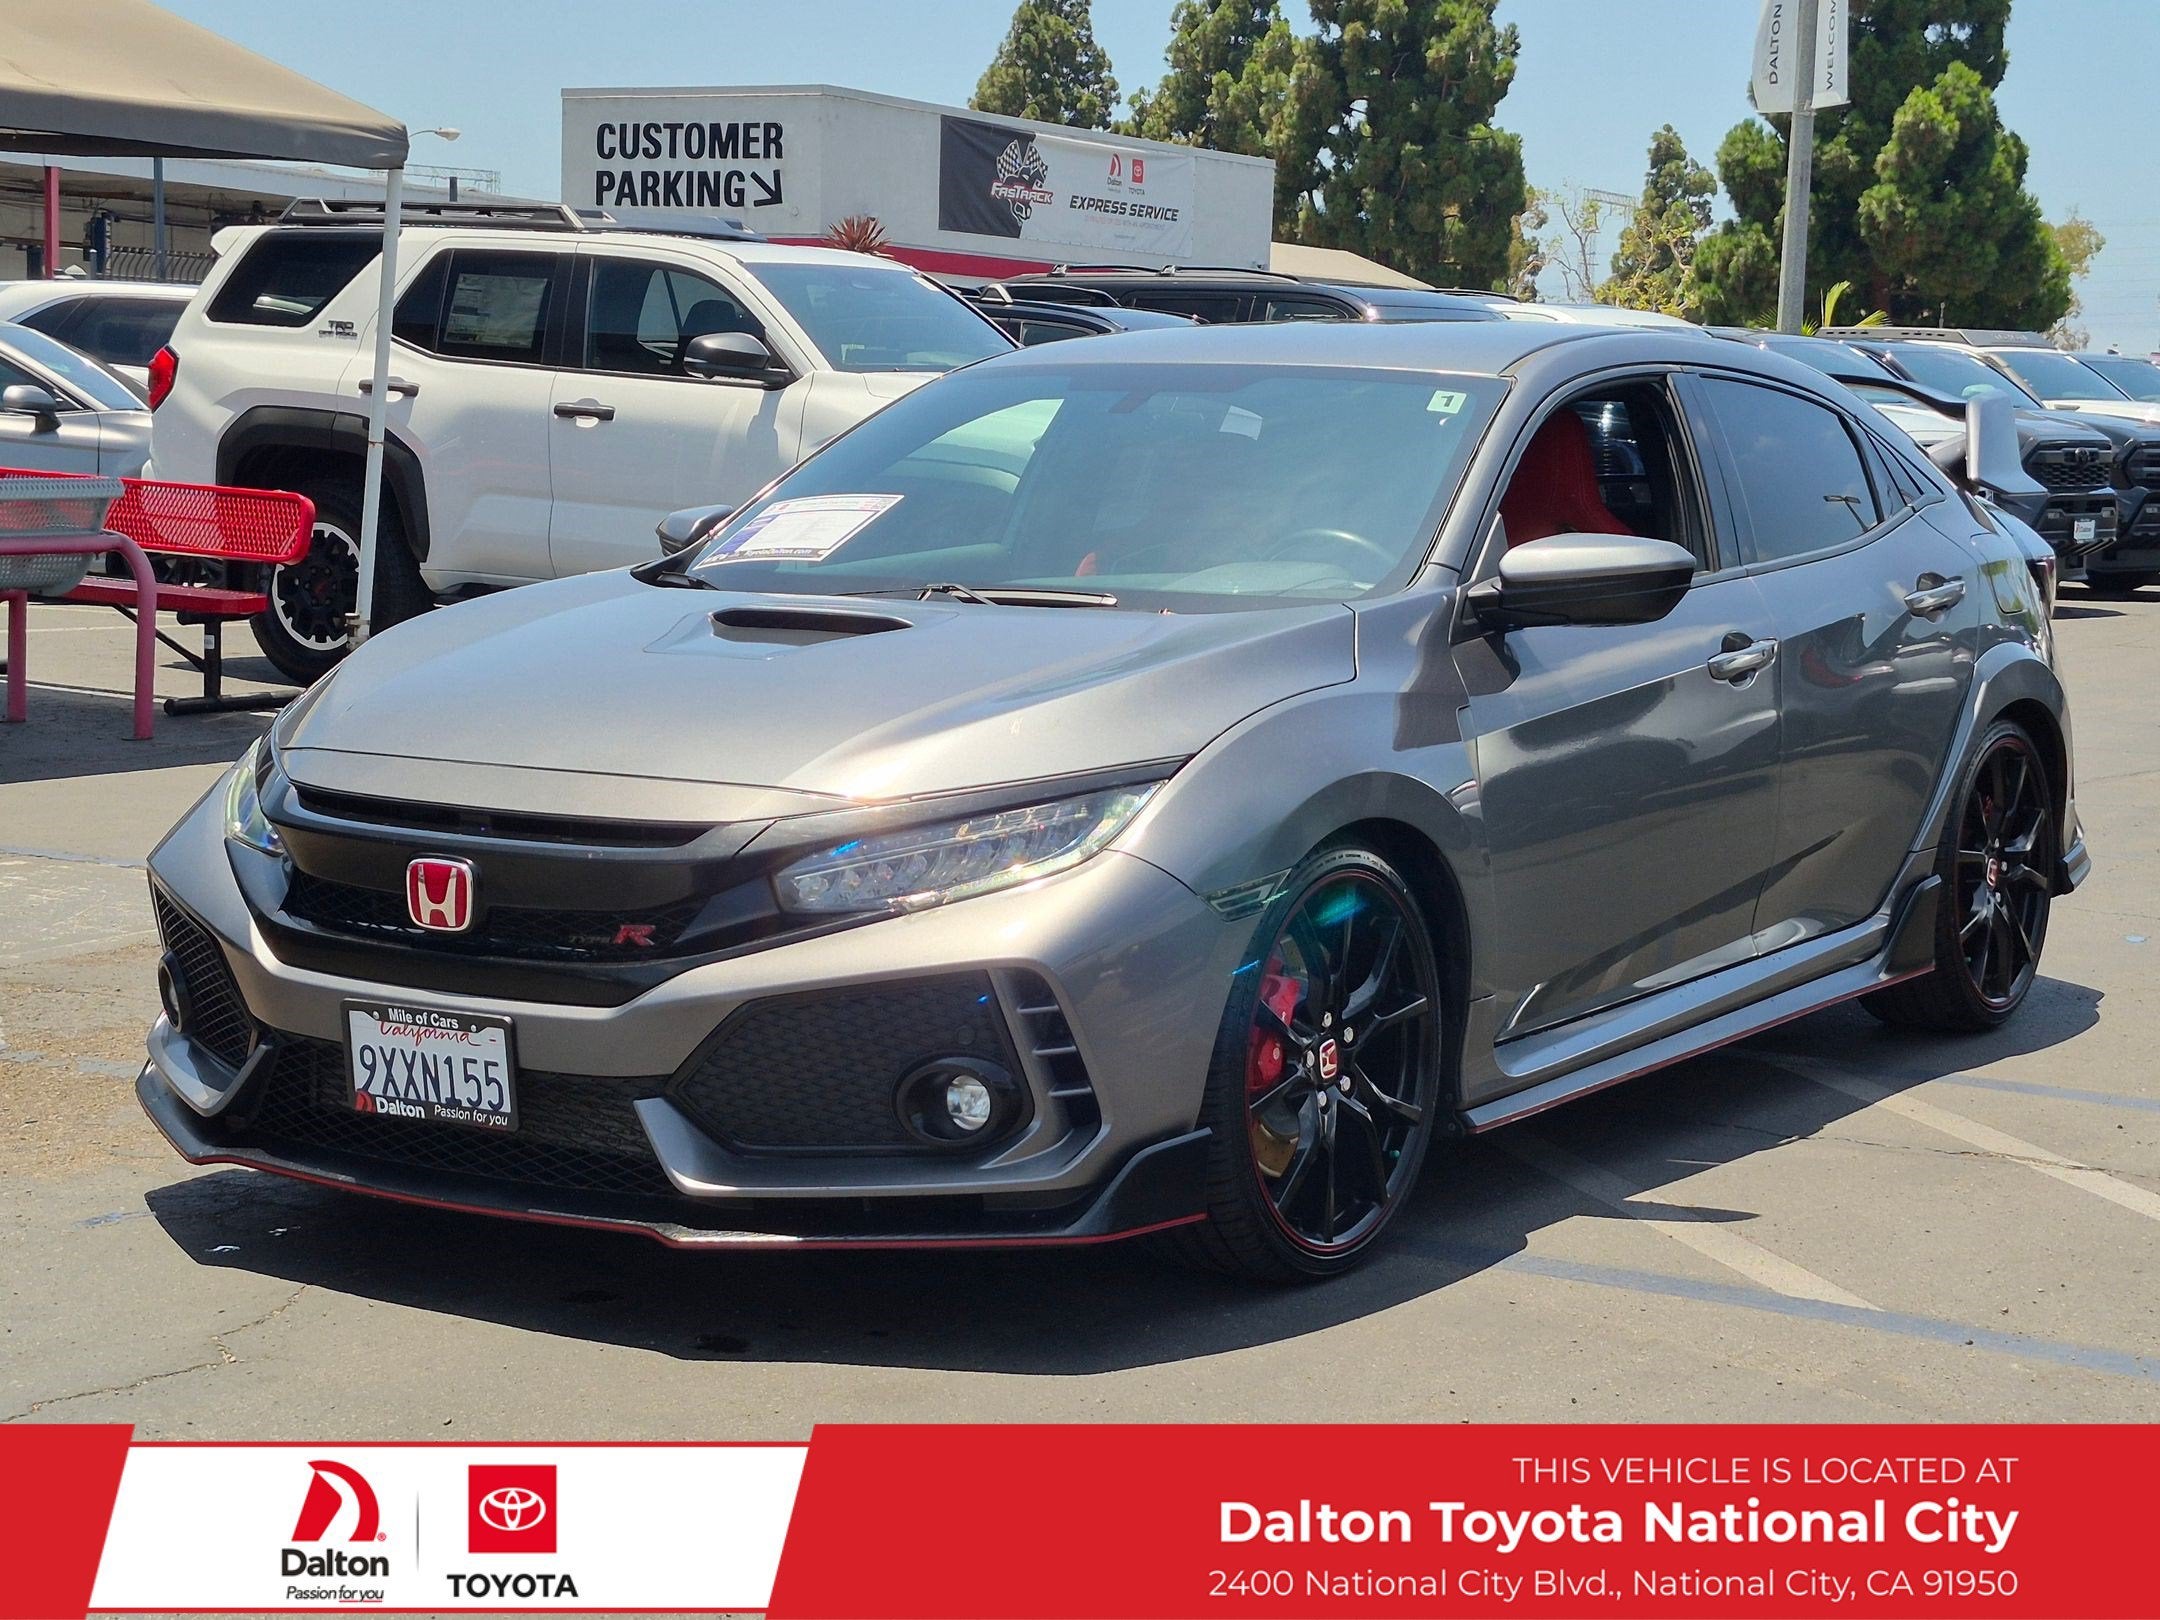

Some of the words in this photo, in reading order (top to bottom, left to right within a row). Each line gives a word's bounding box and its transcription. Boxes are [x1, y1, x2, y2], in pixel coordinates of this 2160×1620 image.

[1769, 4, 1783, 85] DALTON
[596, 122, 784, 159] CUSTOMER
[595, 170, 746, 207] PARKING
[1069, 195, 1128, 216] EXPRESS
[1128, 203, 1180, 222] SERVICE
[388, 1008, 414, 1023] Mile
[415, 1011, 428, 1025] of
[430, 1012, 459, 1030] Cars
[359, 1044, 505, 1111] 9XXN155
[376, 1097, 426, 1119] Dalton
[434, 1104, 471, 1121] Passion
[473, 1110, 487, 1123] for
[489, 1114, 508, 1126] you
